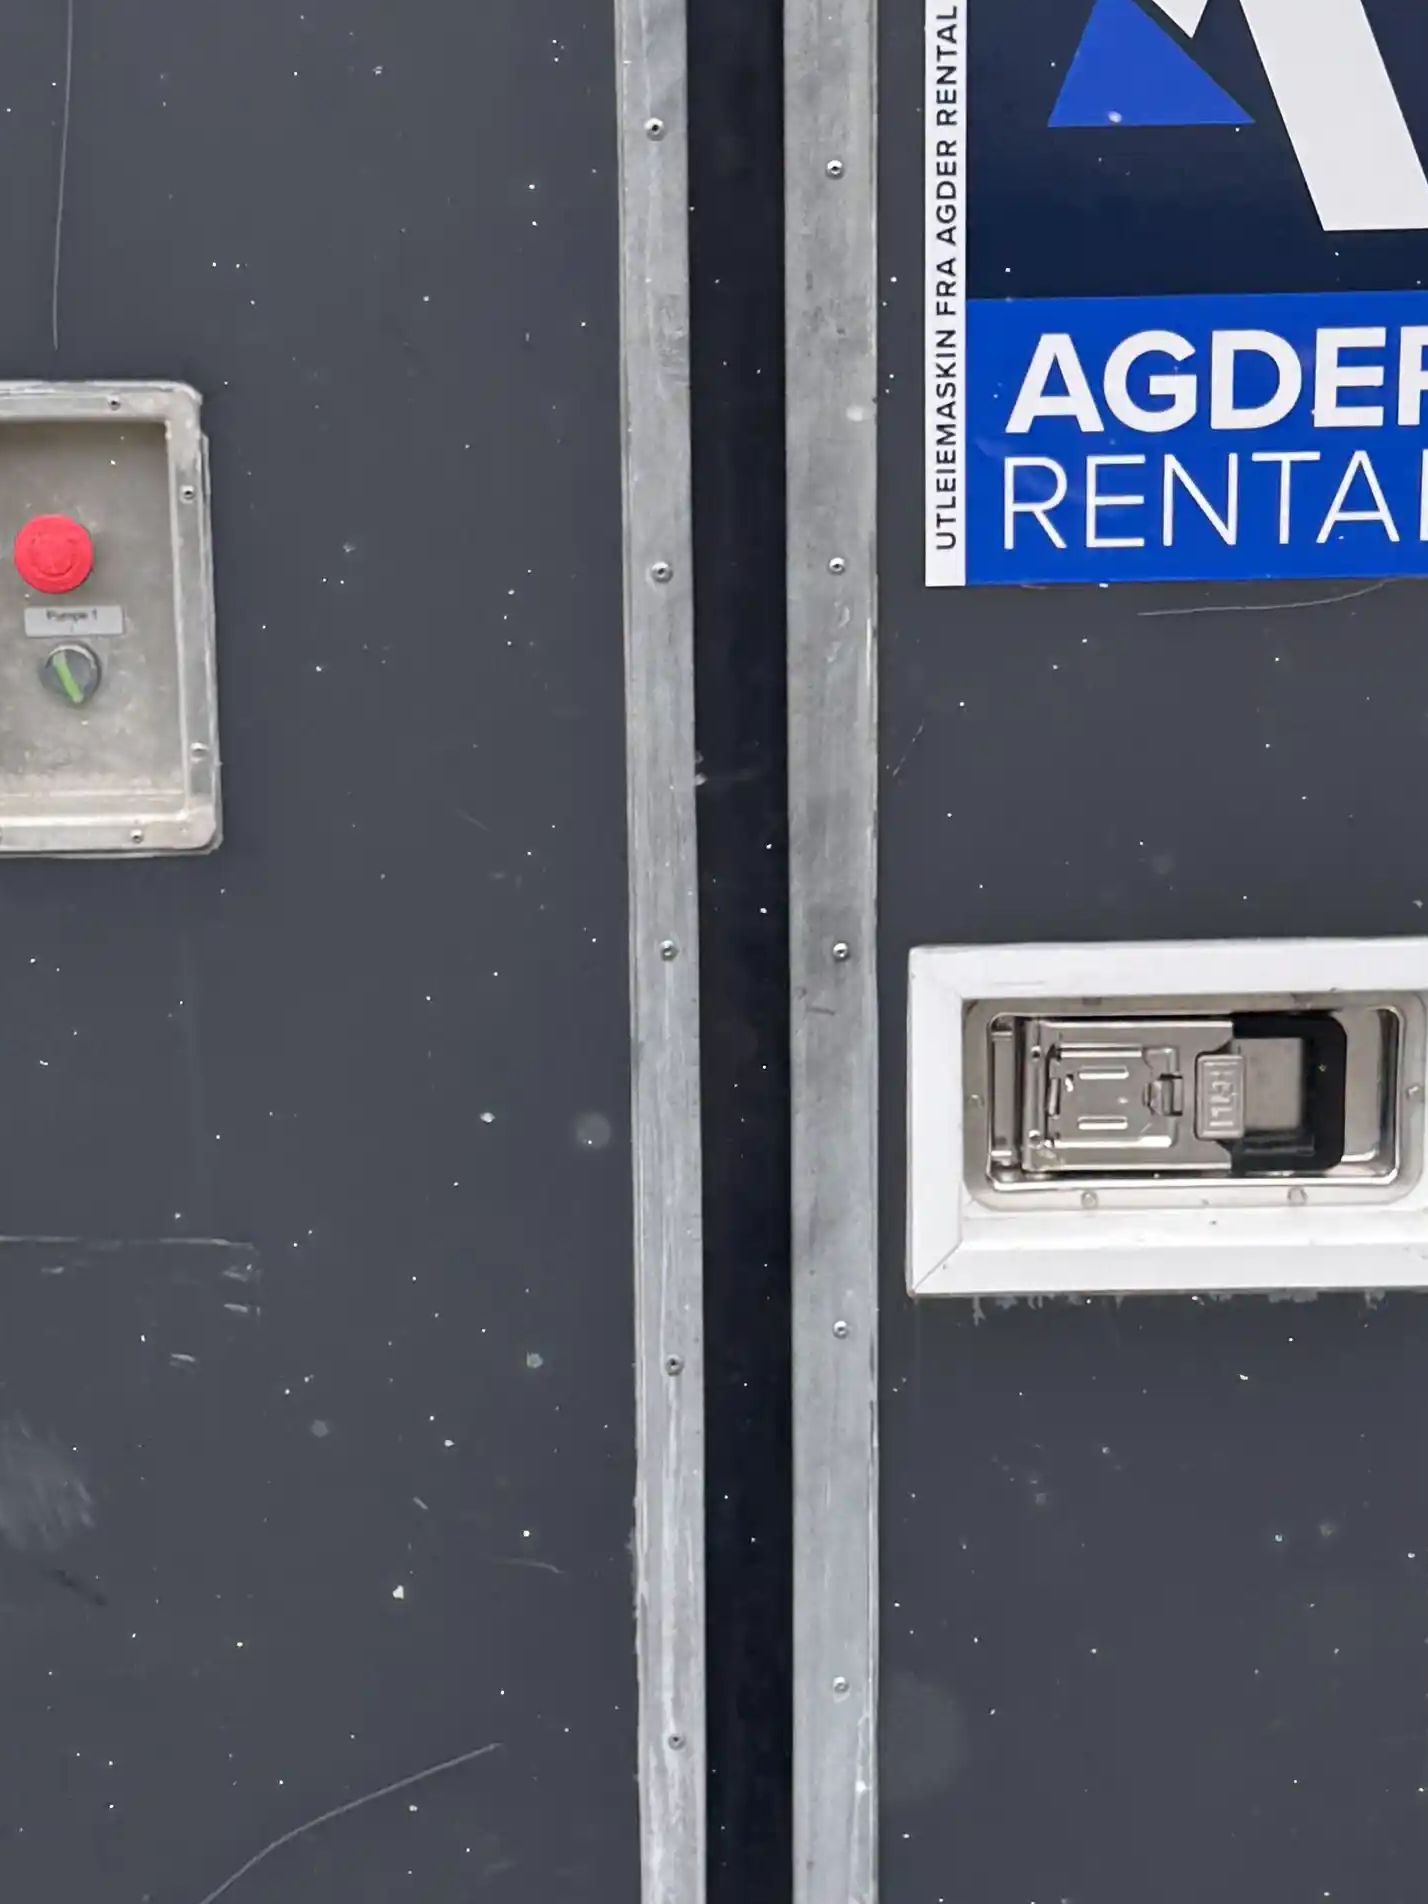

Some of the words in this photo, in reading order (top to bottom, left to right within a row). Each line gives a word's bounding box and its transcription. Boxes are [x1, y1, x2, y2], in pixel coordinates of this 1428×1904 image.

[935, 5, 958, 126] RENTAL
[935, 138, 957, 247] AGDER
[935, 257, 957, 317] FRA
[935, 329, 957, 551] UTLEIEMASKIN
